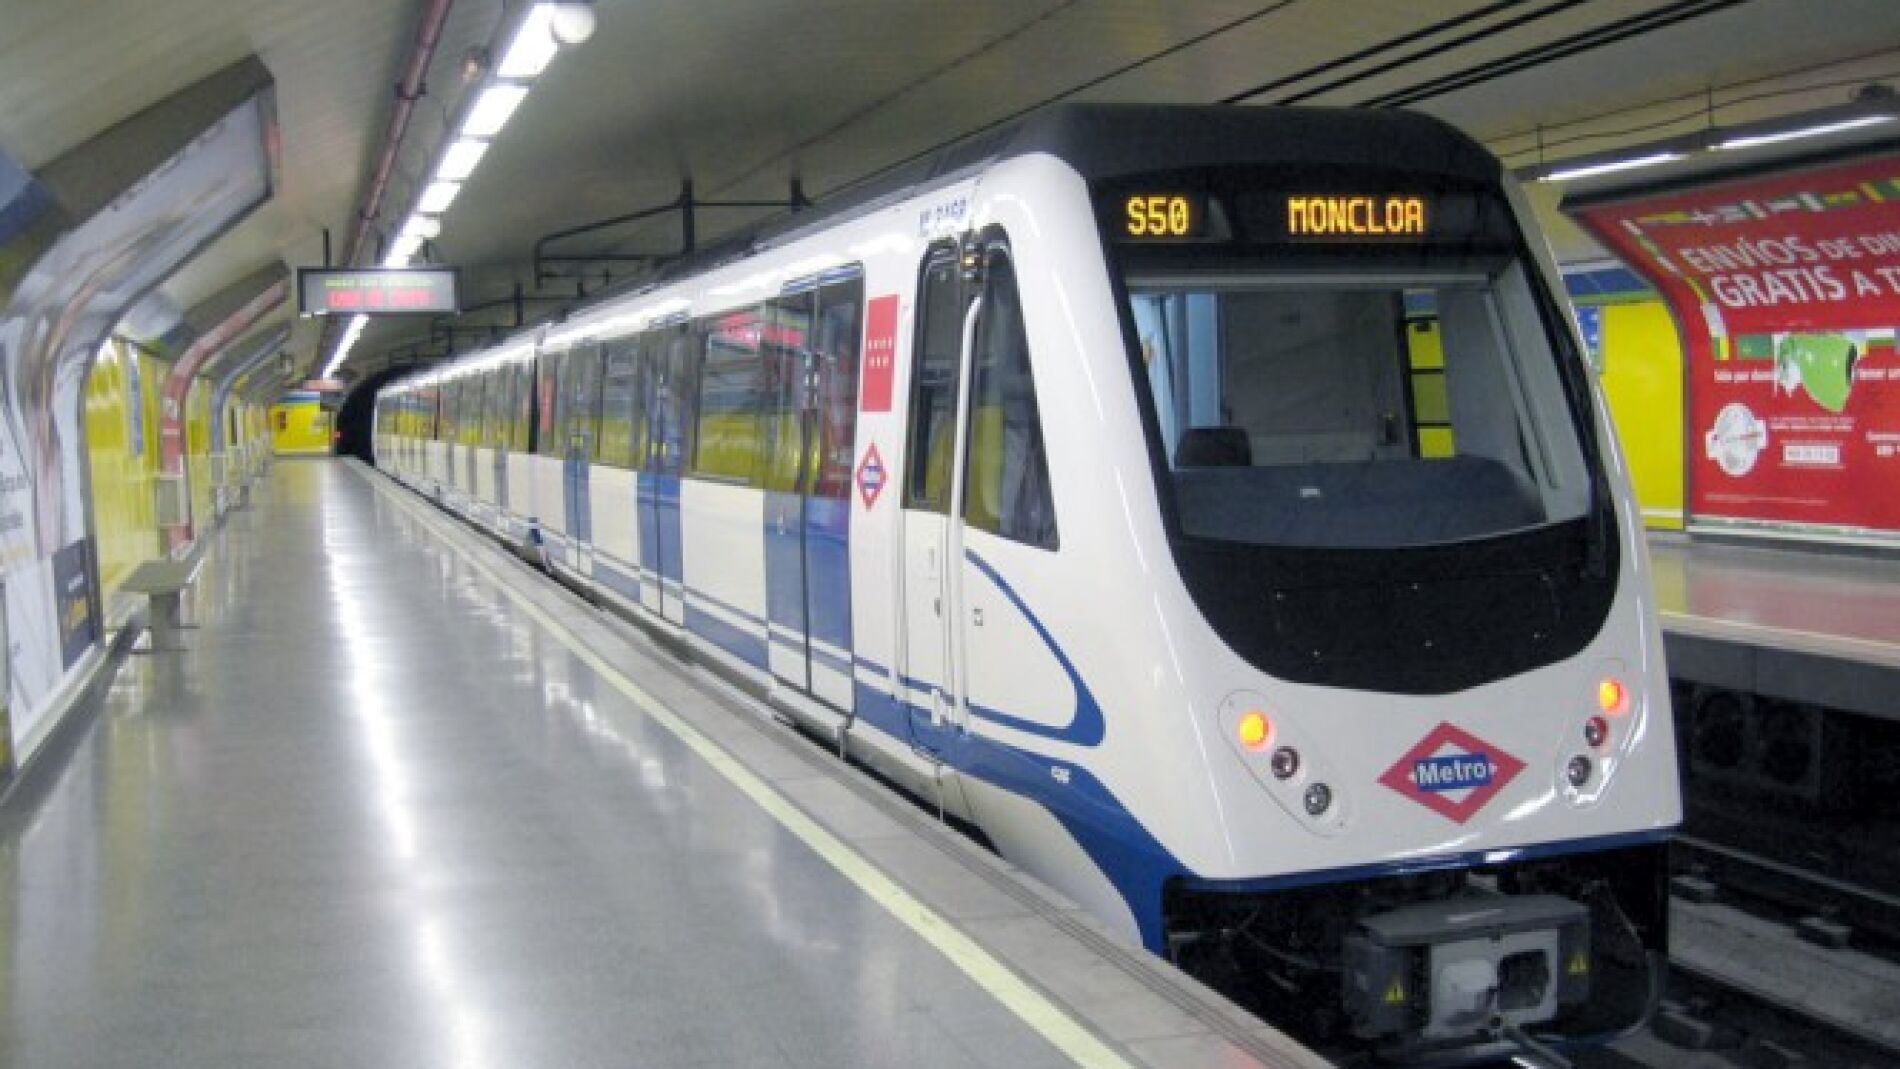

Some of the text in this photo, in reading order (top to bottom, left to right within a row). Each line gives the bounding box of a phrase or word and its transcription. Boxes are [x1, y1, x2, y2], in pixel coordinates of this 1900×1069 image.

[1127, 196, 1425, 236] S50 MONCLOA
[1679, 236, 1820, 273] ENVÍOS
[1816, 237, 1864, 260] DE
[1710, 265, 1847, 308] GRATIS
[1851, 270, 1881, 297] A
[1417, 759, 1487, 785] Metro
